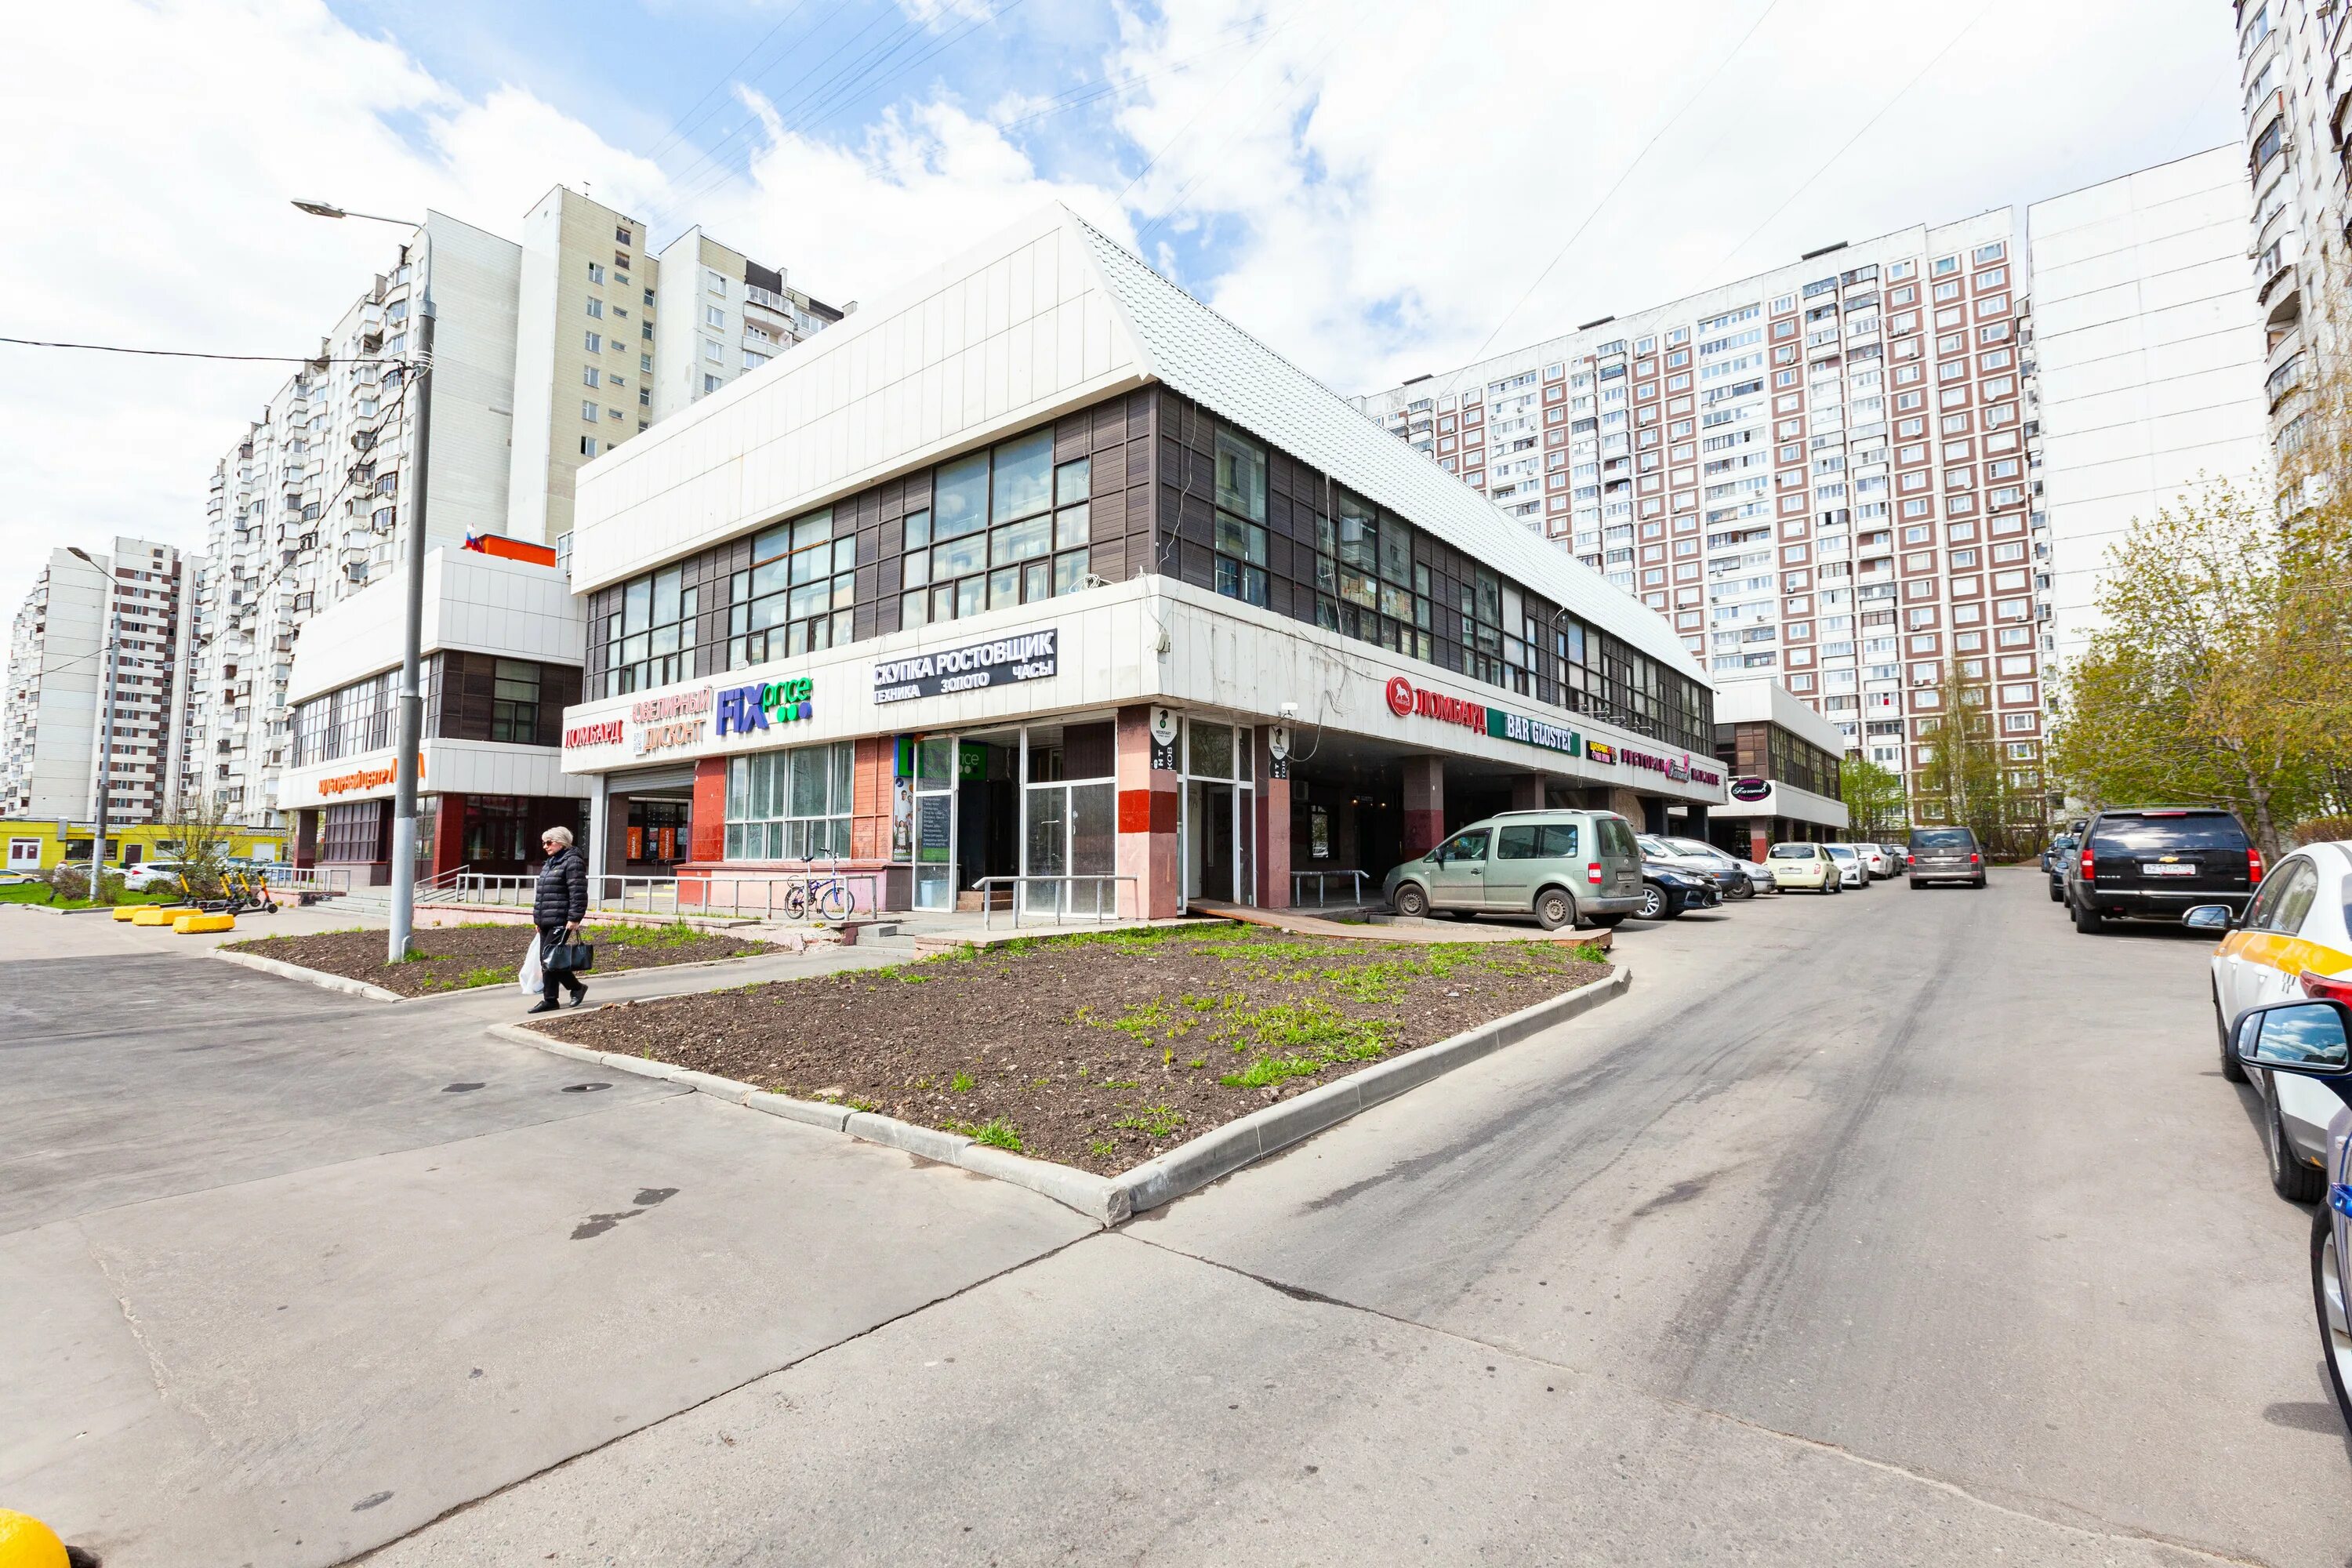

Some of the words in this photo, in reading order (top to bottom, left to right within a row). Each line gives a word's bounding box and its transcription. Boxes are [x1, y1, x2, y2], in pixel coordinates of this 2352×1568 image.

[874, 656, 935, 686] СКУПКА
[936, 631, 1054, 675] РОСТОВЩИК
[873, 684, 921, 703] ТЕХНИКА
[941, 672, 990, 693] ЗОЛОТО
[1012, 660, 1054, 681] ЧАСЫ
[633, 684, 713, 724] ЮВЕЛИРНЫЙ
[716, 683, 769, 735] FIX
[1415, 688, 1486, 735] ЛОМБАРД
[565, 719, 624, 749] ЛОМБАРД
[644, 719, 706, 753] ДИСКОНТ
[1504, 713, 1530, 742] BAR
[318, 771, 361, 796] КУЛЬТУРНЫЙ
[361, 768, 390, 789] ЦЕНТР
[1621, 748, 1665, 772] РЕСТОРАН
[1691, 768, 1720, 786] КАРАОКЕ
